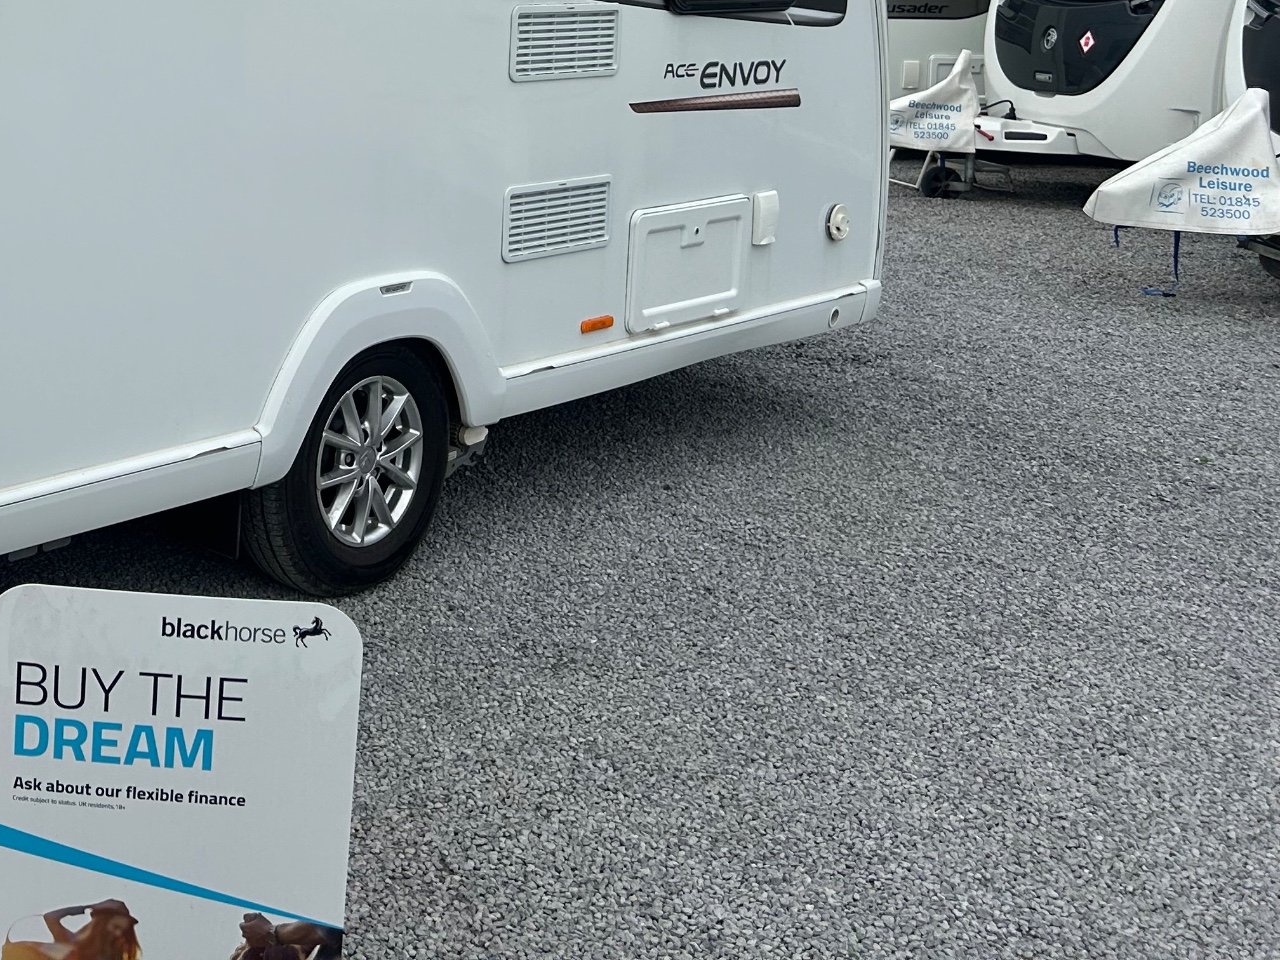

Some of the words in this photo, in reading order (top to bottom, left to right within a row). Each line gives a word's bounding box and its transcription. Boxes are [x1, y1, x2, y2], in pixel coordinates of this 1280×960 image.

[887, 2, 950, 14] usader
[663, 63, 700, 79] ACE
[700, 59, 787, 90] ENVOY
[908, 99, 962, 113] Beechwood
[914, 110, 951, 120] Leisure
[926, 122, 956, 131] 01845
[913, 131, 949, 140] 523500
[1187, 161, 1270, 178] Beechwood
[1199, 177, 1253, 192] Leisure
[1192, 193, 1217, 205] TEL:
[1218, 195, 1261, 208] 01845
[1200, 207, 1251, 220] 523500
[161, 616, 287, 644] blackhorse
[15, 661, 125, 713] BUY
[139, 671, 249, 722] THE
[13, 713, 214, 772] DREAM
[13, 776, 43, 792] Ask
[45, 780, 92, 796] about
[95, 786, 122, 798] our
[126, 785, 184, 804] flexible
[187, 790, 247, 807] finance
